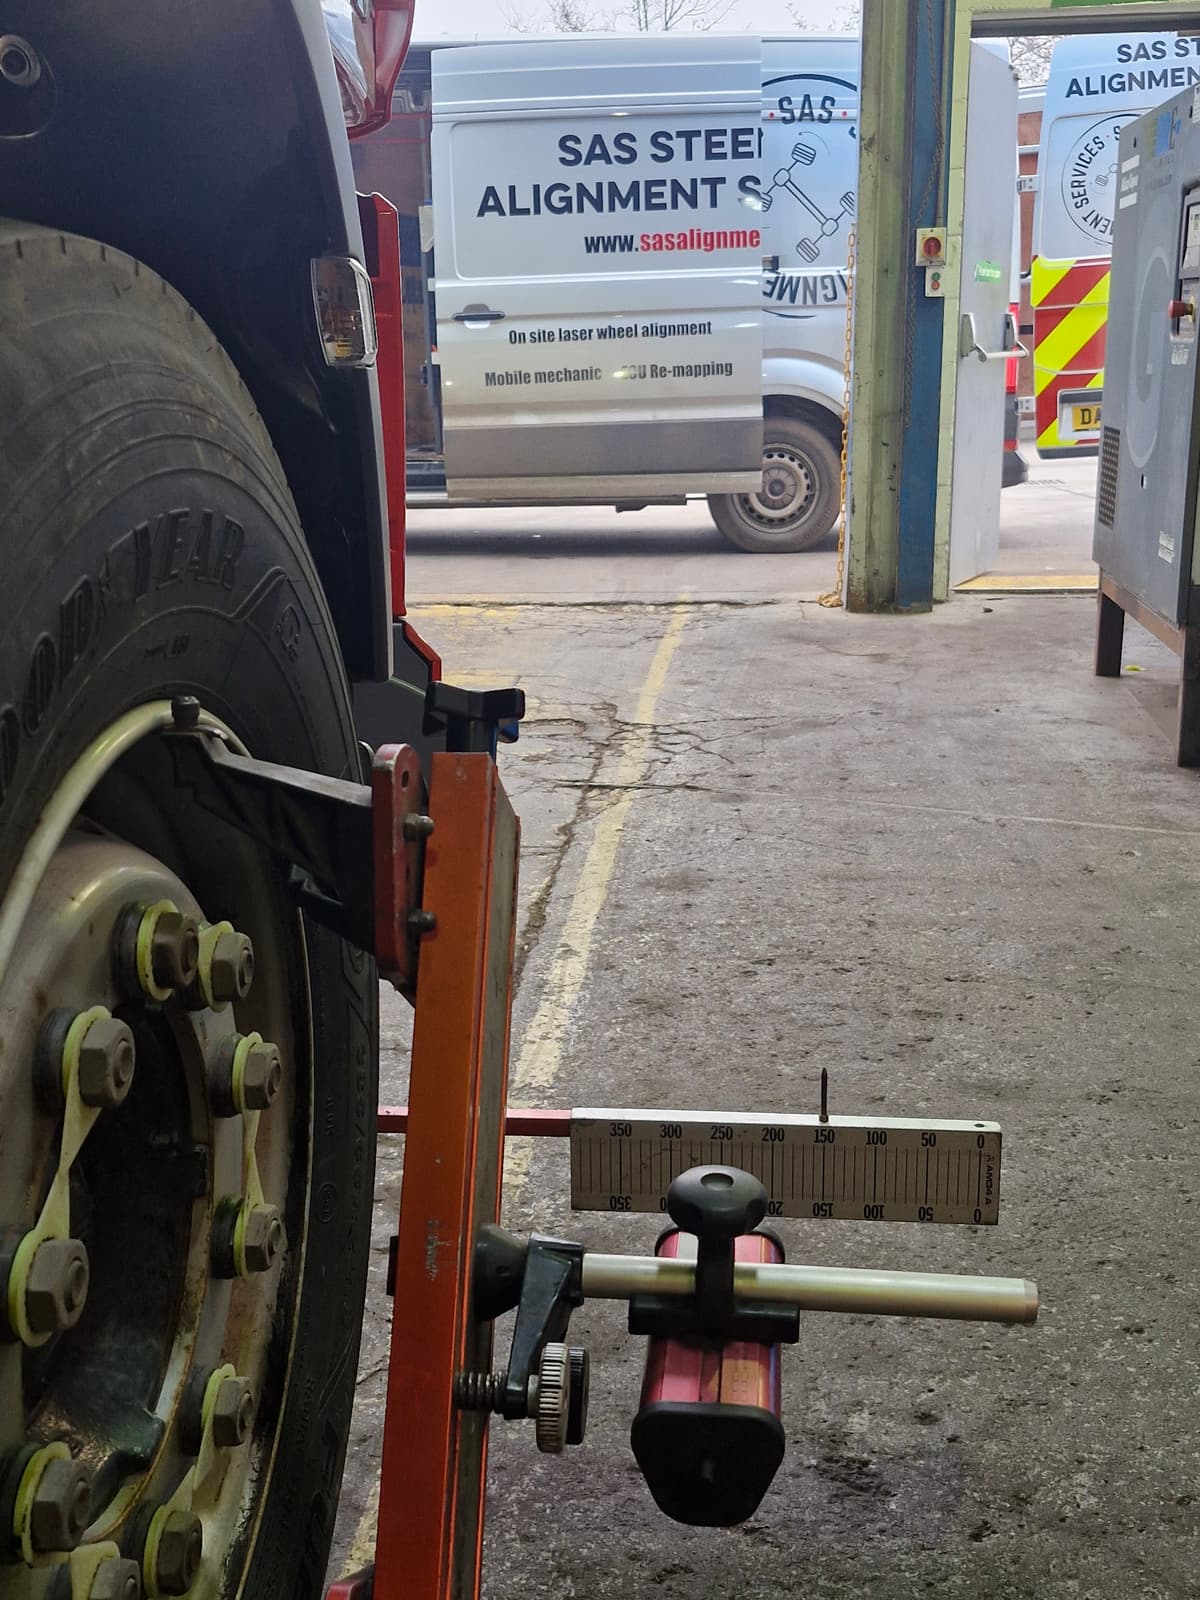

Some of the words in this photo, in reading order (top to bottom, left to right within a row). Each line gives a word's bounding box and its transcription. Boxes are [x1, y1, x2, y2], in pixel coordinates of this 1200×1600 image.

[1116, 40, 1167, 64] SAS
[778, 93, 836, 125] SAS
[558, 133, 638, 168] SAS
[1070, 135, 1106, 210] SERVICES
[476, 175, 728, 219] ALIGNMENT
[584, 226, 761, 255] www.sasalignme
[508, 329, 527, 345] On
[529, 327, 556, 344] site
[558, 326, 594, 343] laser
[596, 323, 638, 341] wheel
[641, 320, 713, 340] alignment
[484, 370, 532, 388] Mobile
[534, 365, 602, 385] mechanic
[649, 361, 734, 379] Re-mapping
[609, 1123, 632, 1138] 350
[659, 1124, 682, 1139] 300
[710, 1125, 734, 1141] 250
[761, 1127, 785, 1143] 200
[813, 1128, 836, 1144] 150
[865, 1130, 888, 1146] 100
[920, 1132, 937, 1148] 50
[976, 1134, 985, 1150] 0
[609, 1195, 632, 1210] 350
[767, 1200, 784, 1216] 20
[812, 1202, 834, 1218] 150
[862, 1204, 885, 1220] 100
[917, 1206, 934, 1222] 50
[973, 1208, 983, 1223] 0
